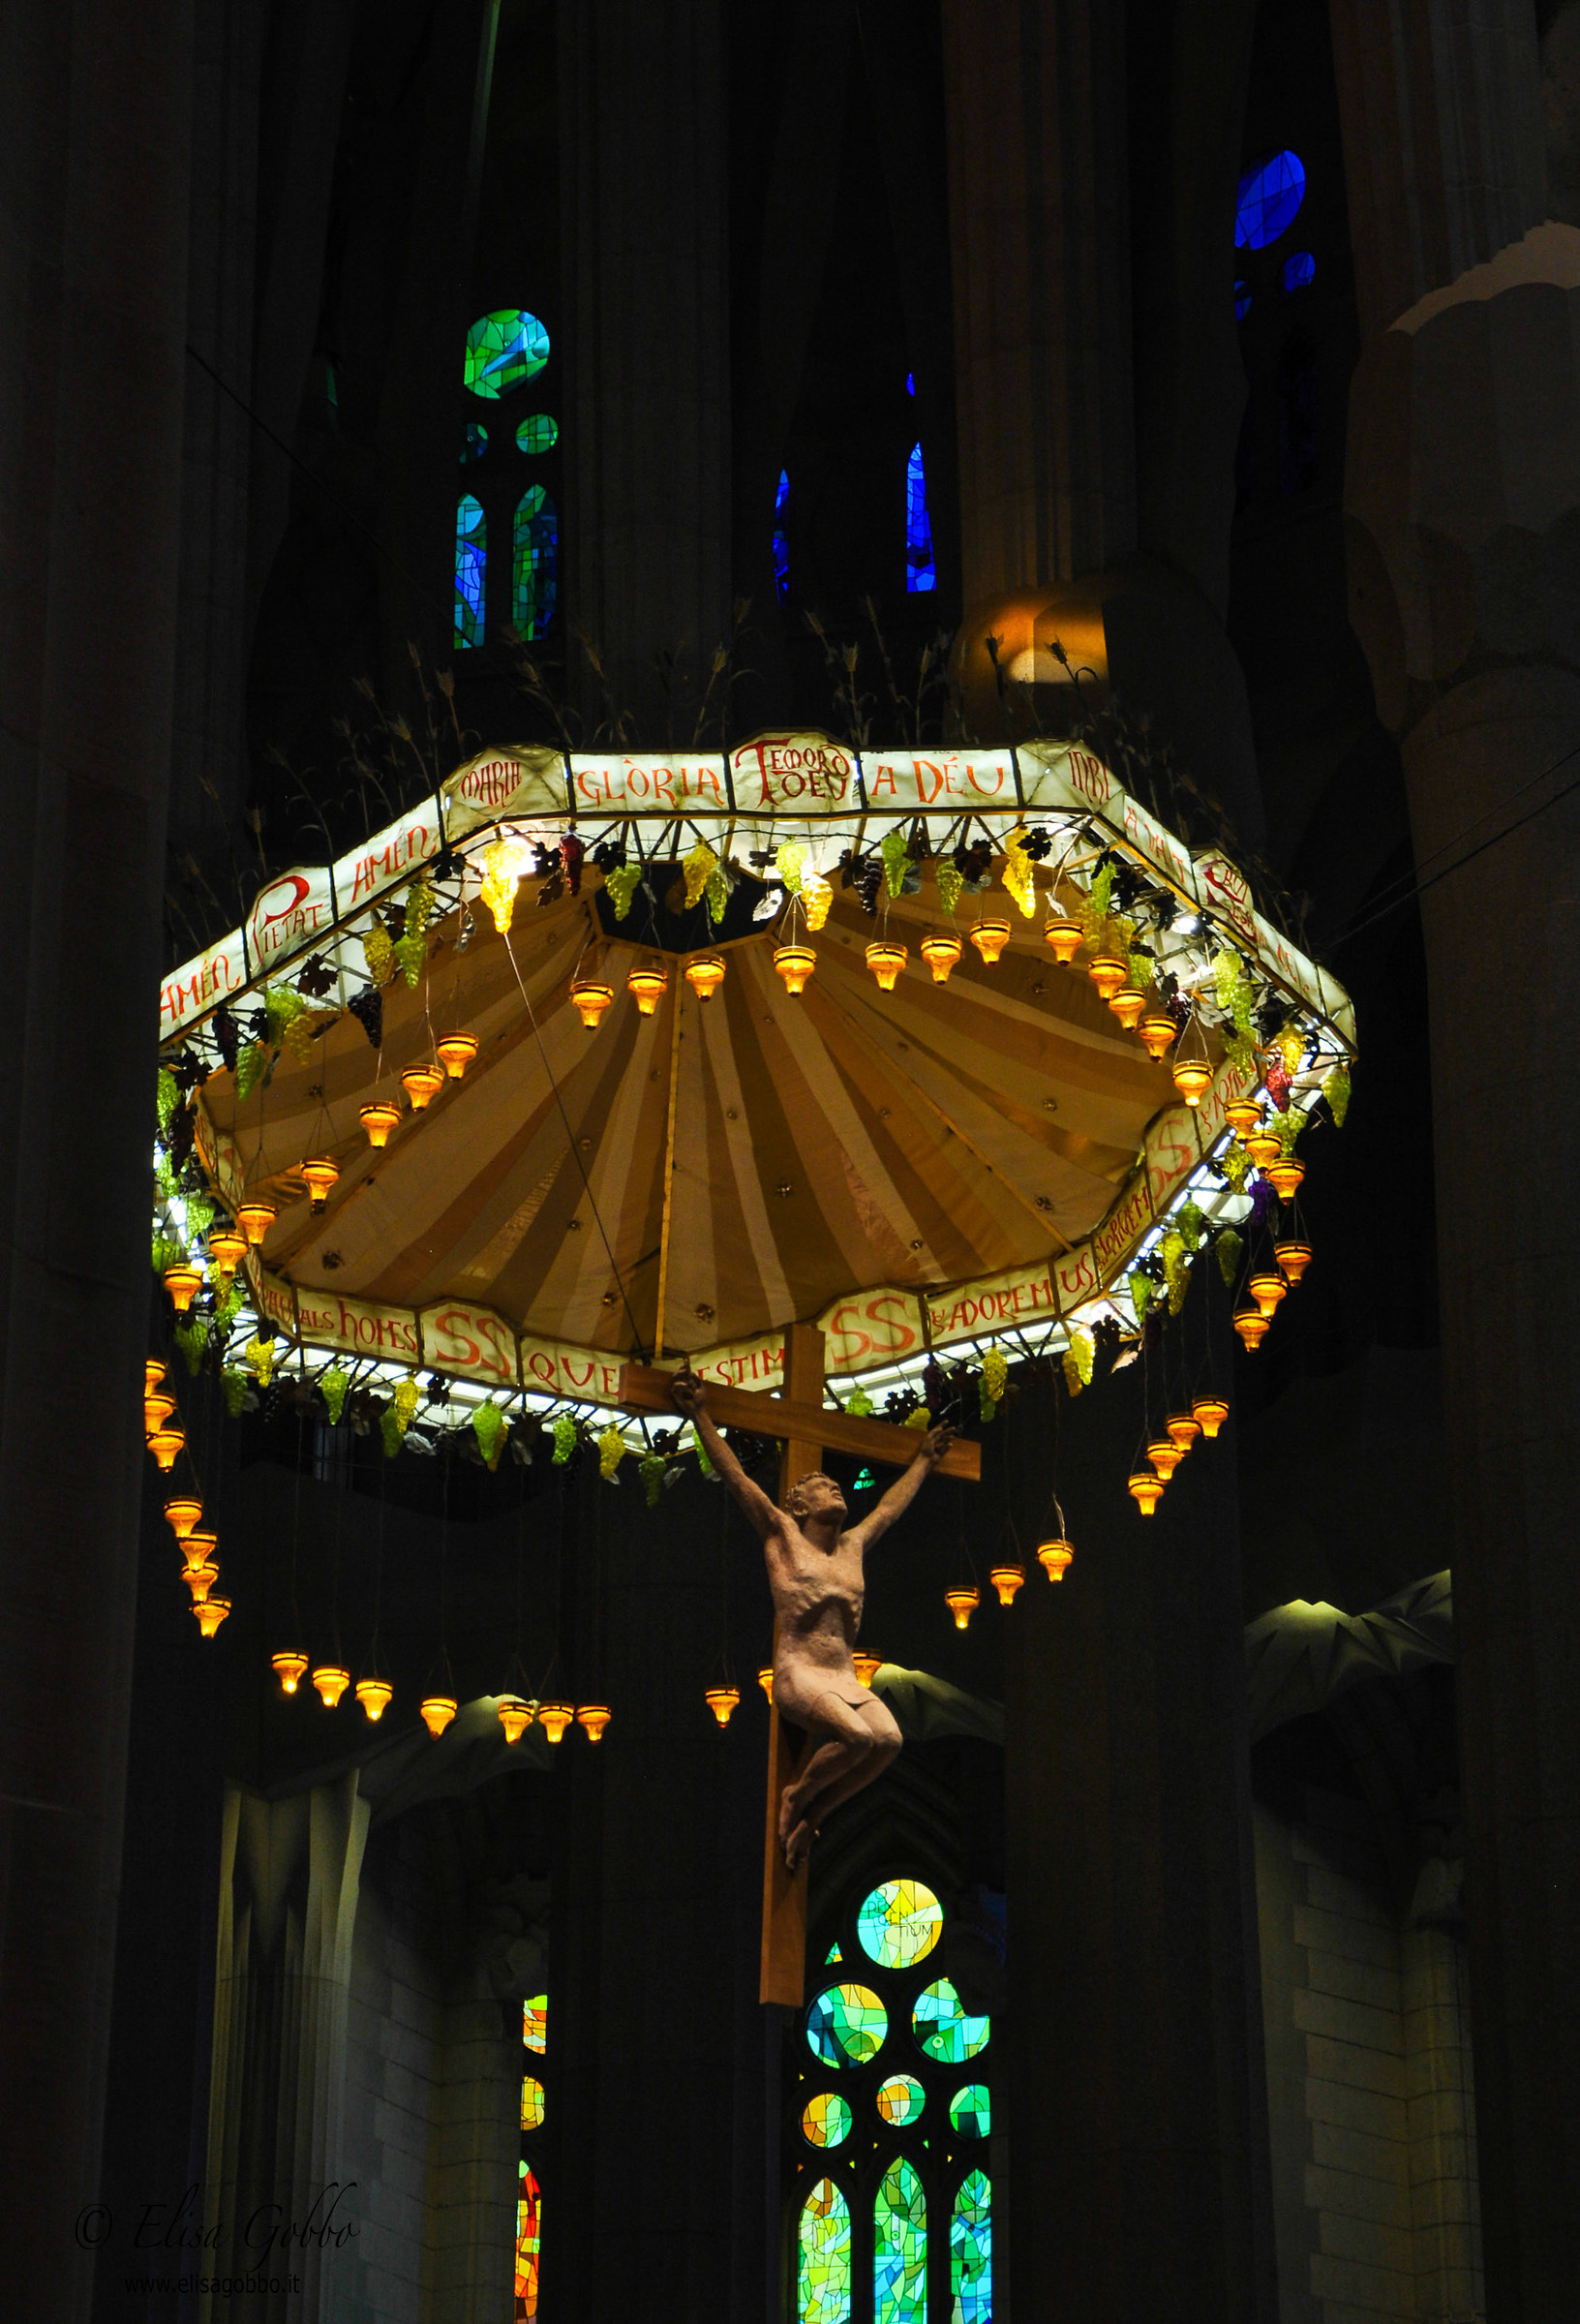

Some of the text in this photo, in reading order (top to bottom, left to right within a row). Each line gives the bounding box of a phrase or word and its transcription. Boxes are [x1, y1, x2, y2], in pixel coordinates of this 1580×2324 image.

[577, 758, 724, 810] GLÒRIA
[871, 755, 1004, 805] A DÉU
[1060, 1256, 1094, 1294] US
[300, 1308, 335, 1330] ALS
[949, 1278, 1054, 1331] ADOREM
[434, 1310, 511, 1379] SS
[831, 1296, 916, 1367] SS
[529, 1352, 620, 1396] QUE
